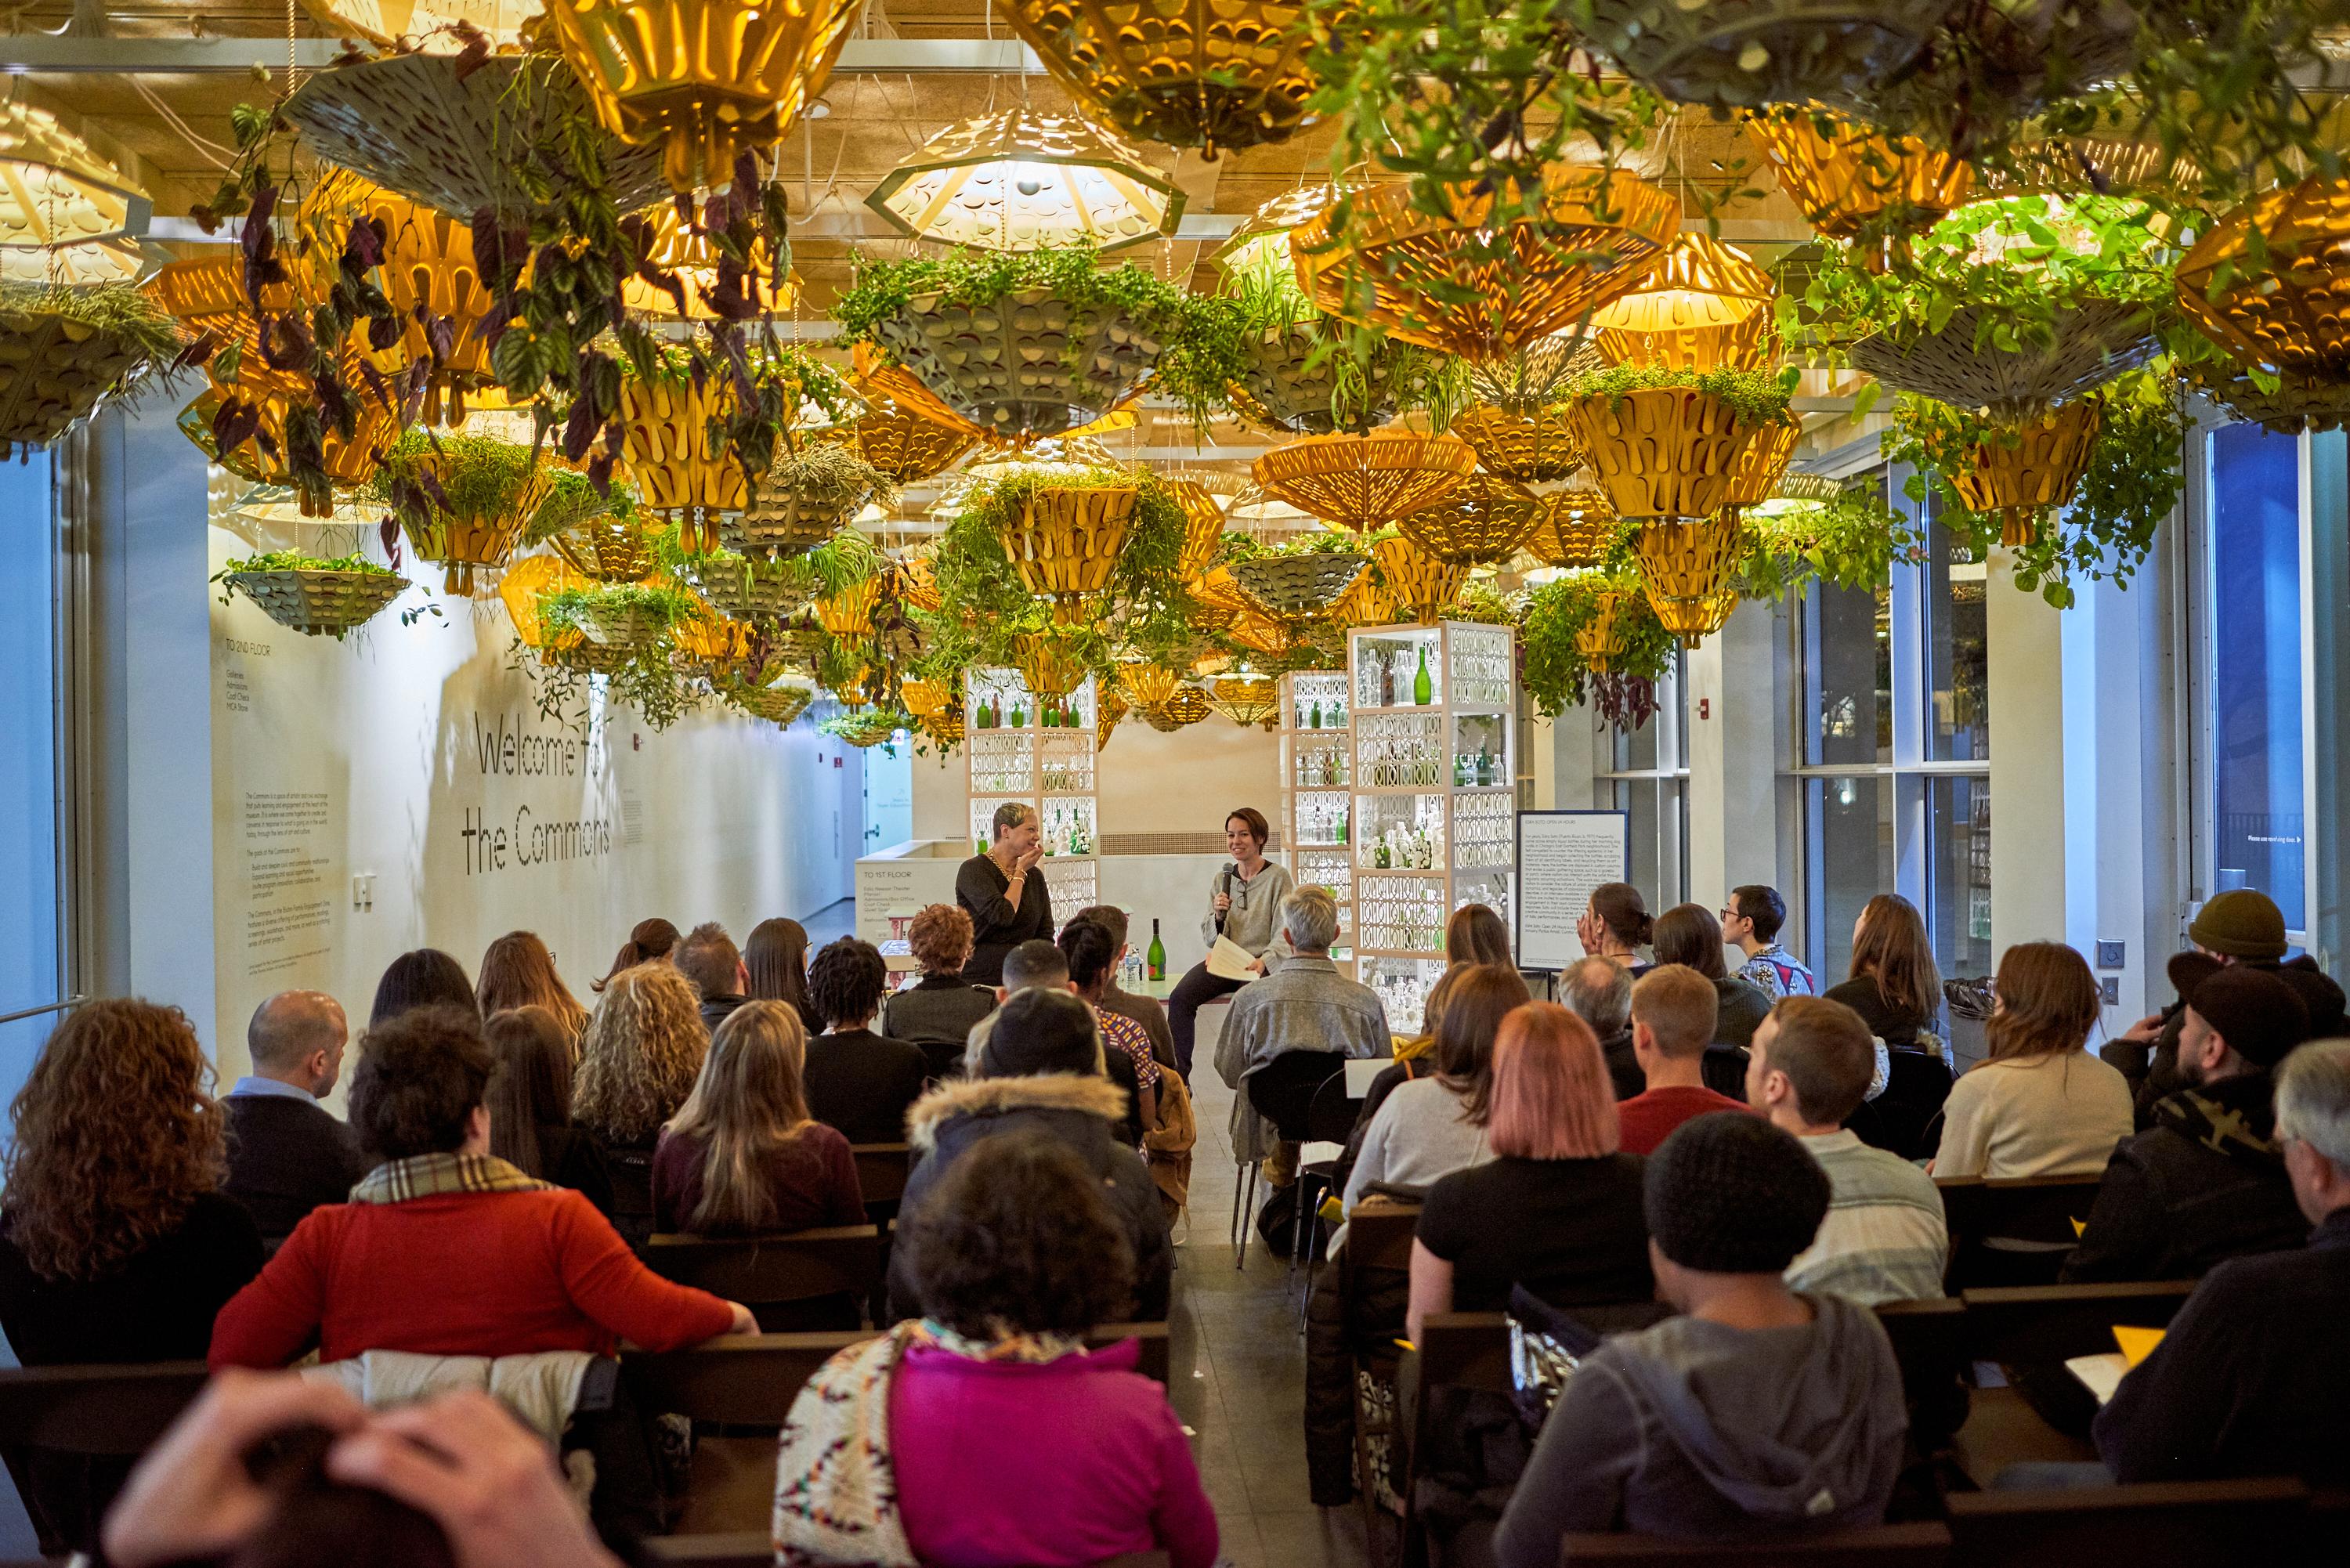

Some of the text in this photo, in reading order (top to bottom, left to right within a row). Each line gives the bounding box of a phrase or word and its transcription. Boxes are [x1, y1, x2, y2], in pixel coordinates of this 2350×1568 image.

[226, 638, 271, 656] TO 2ND FLOOR
[475, 711, 600, 778] Welcome to
[461, 807, 507, 876] the
[515, 804, 609, 866] Commons
